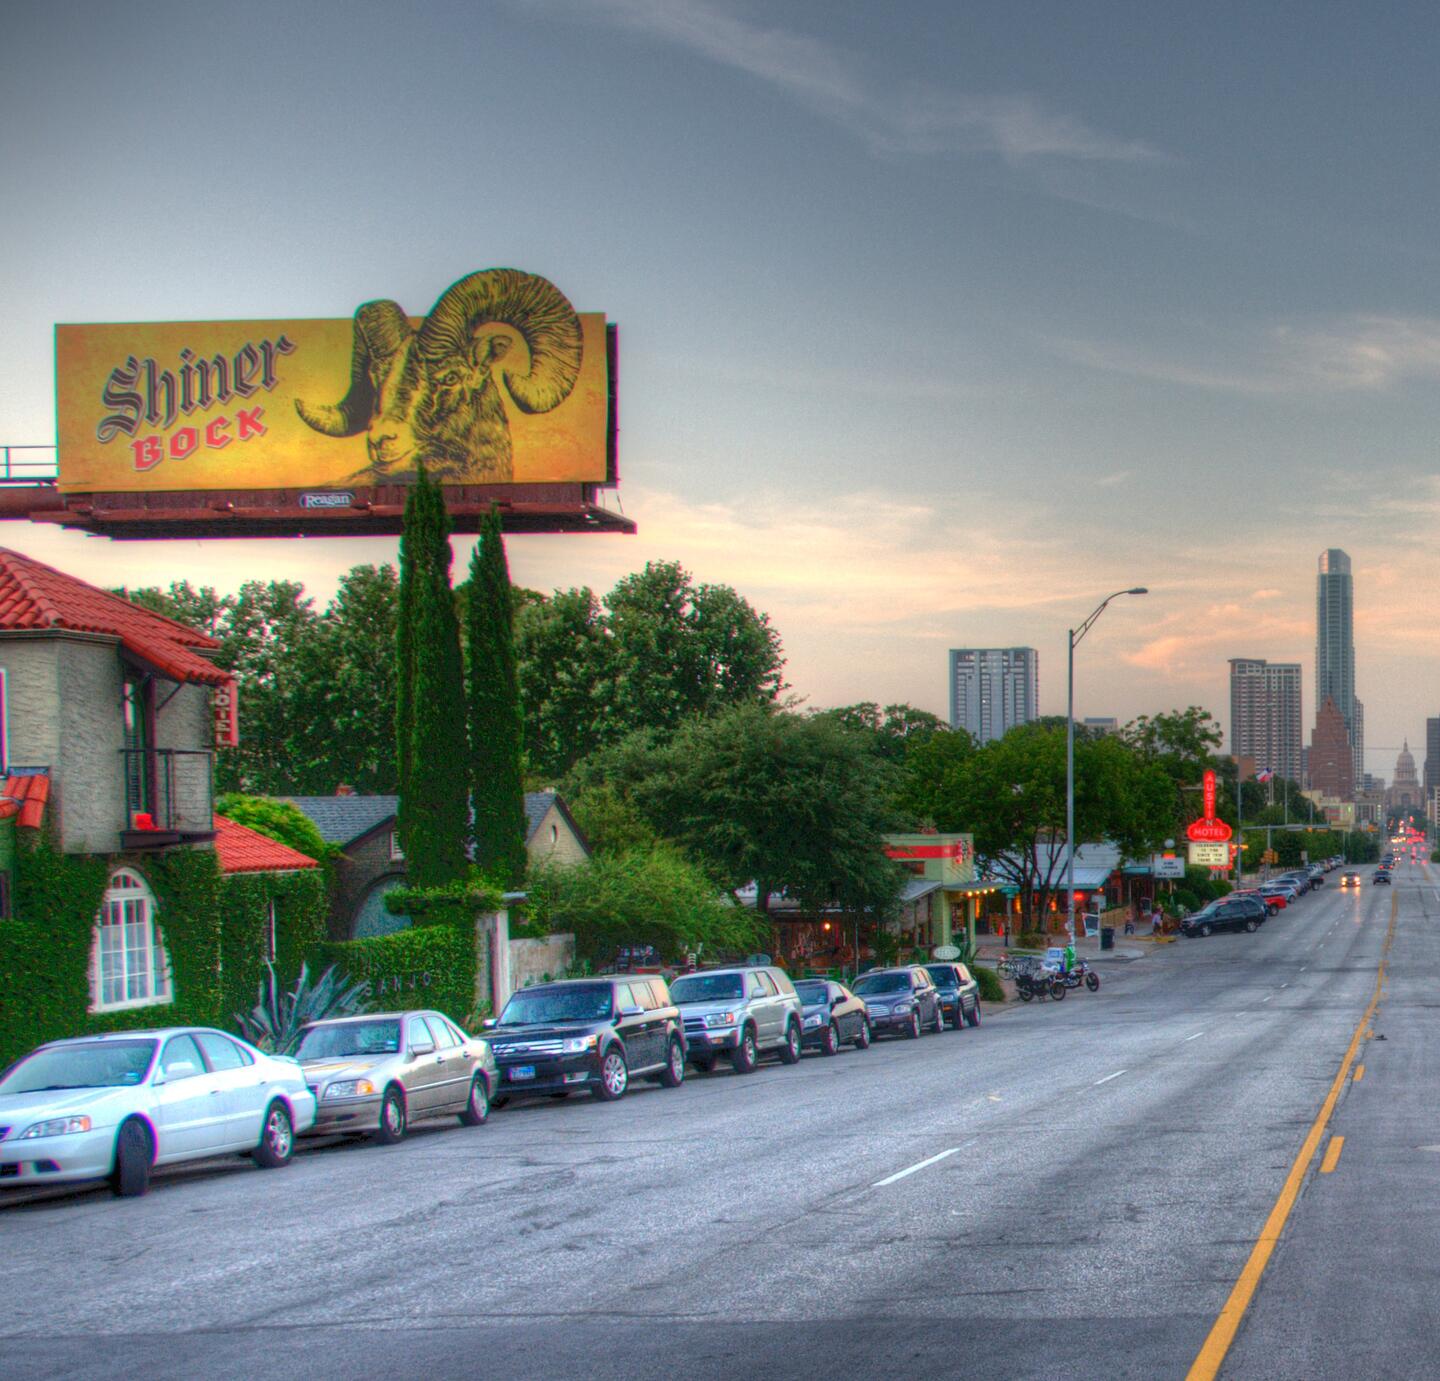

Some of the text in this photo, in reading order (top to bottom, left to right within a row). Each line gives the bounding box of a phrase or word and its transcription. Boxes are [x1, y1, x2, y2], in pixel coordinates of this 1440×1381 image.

[96, 335, 297, 444] Shiner
[130, 405, 267, 471] BOCK
[303, 494, 350, 507] Reagan
[1205, 773, 1214, 827] AUSTIN
[1193, 828, 1225, 837] MOTEL
